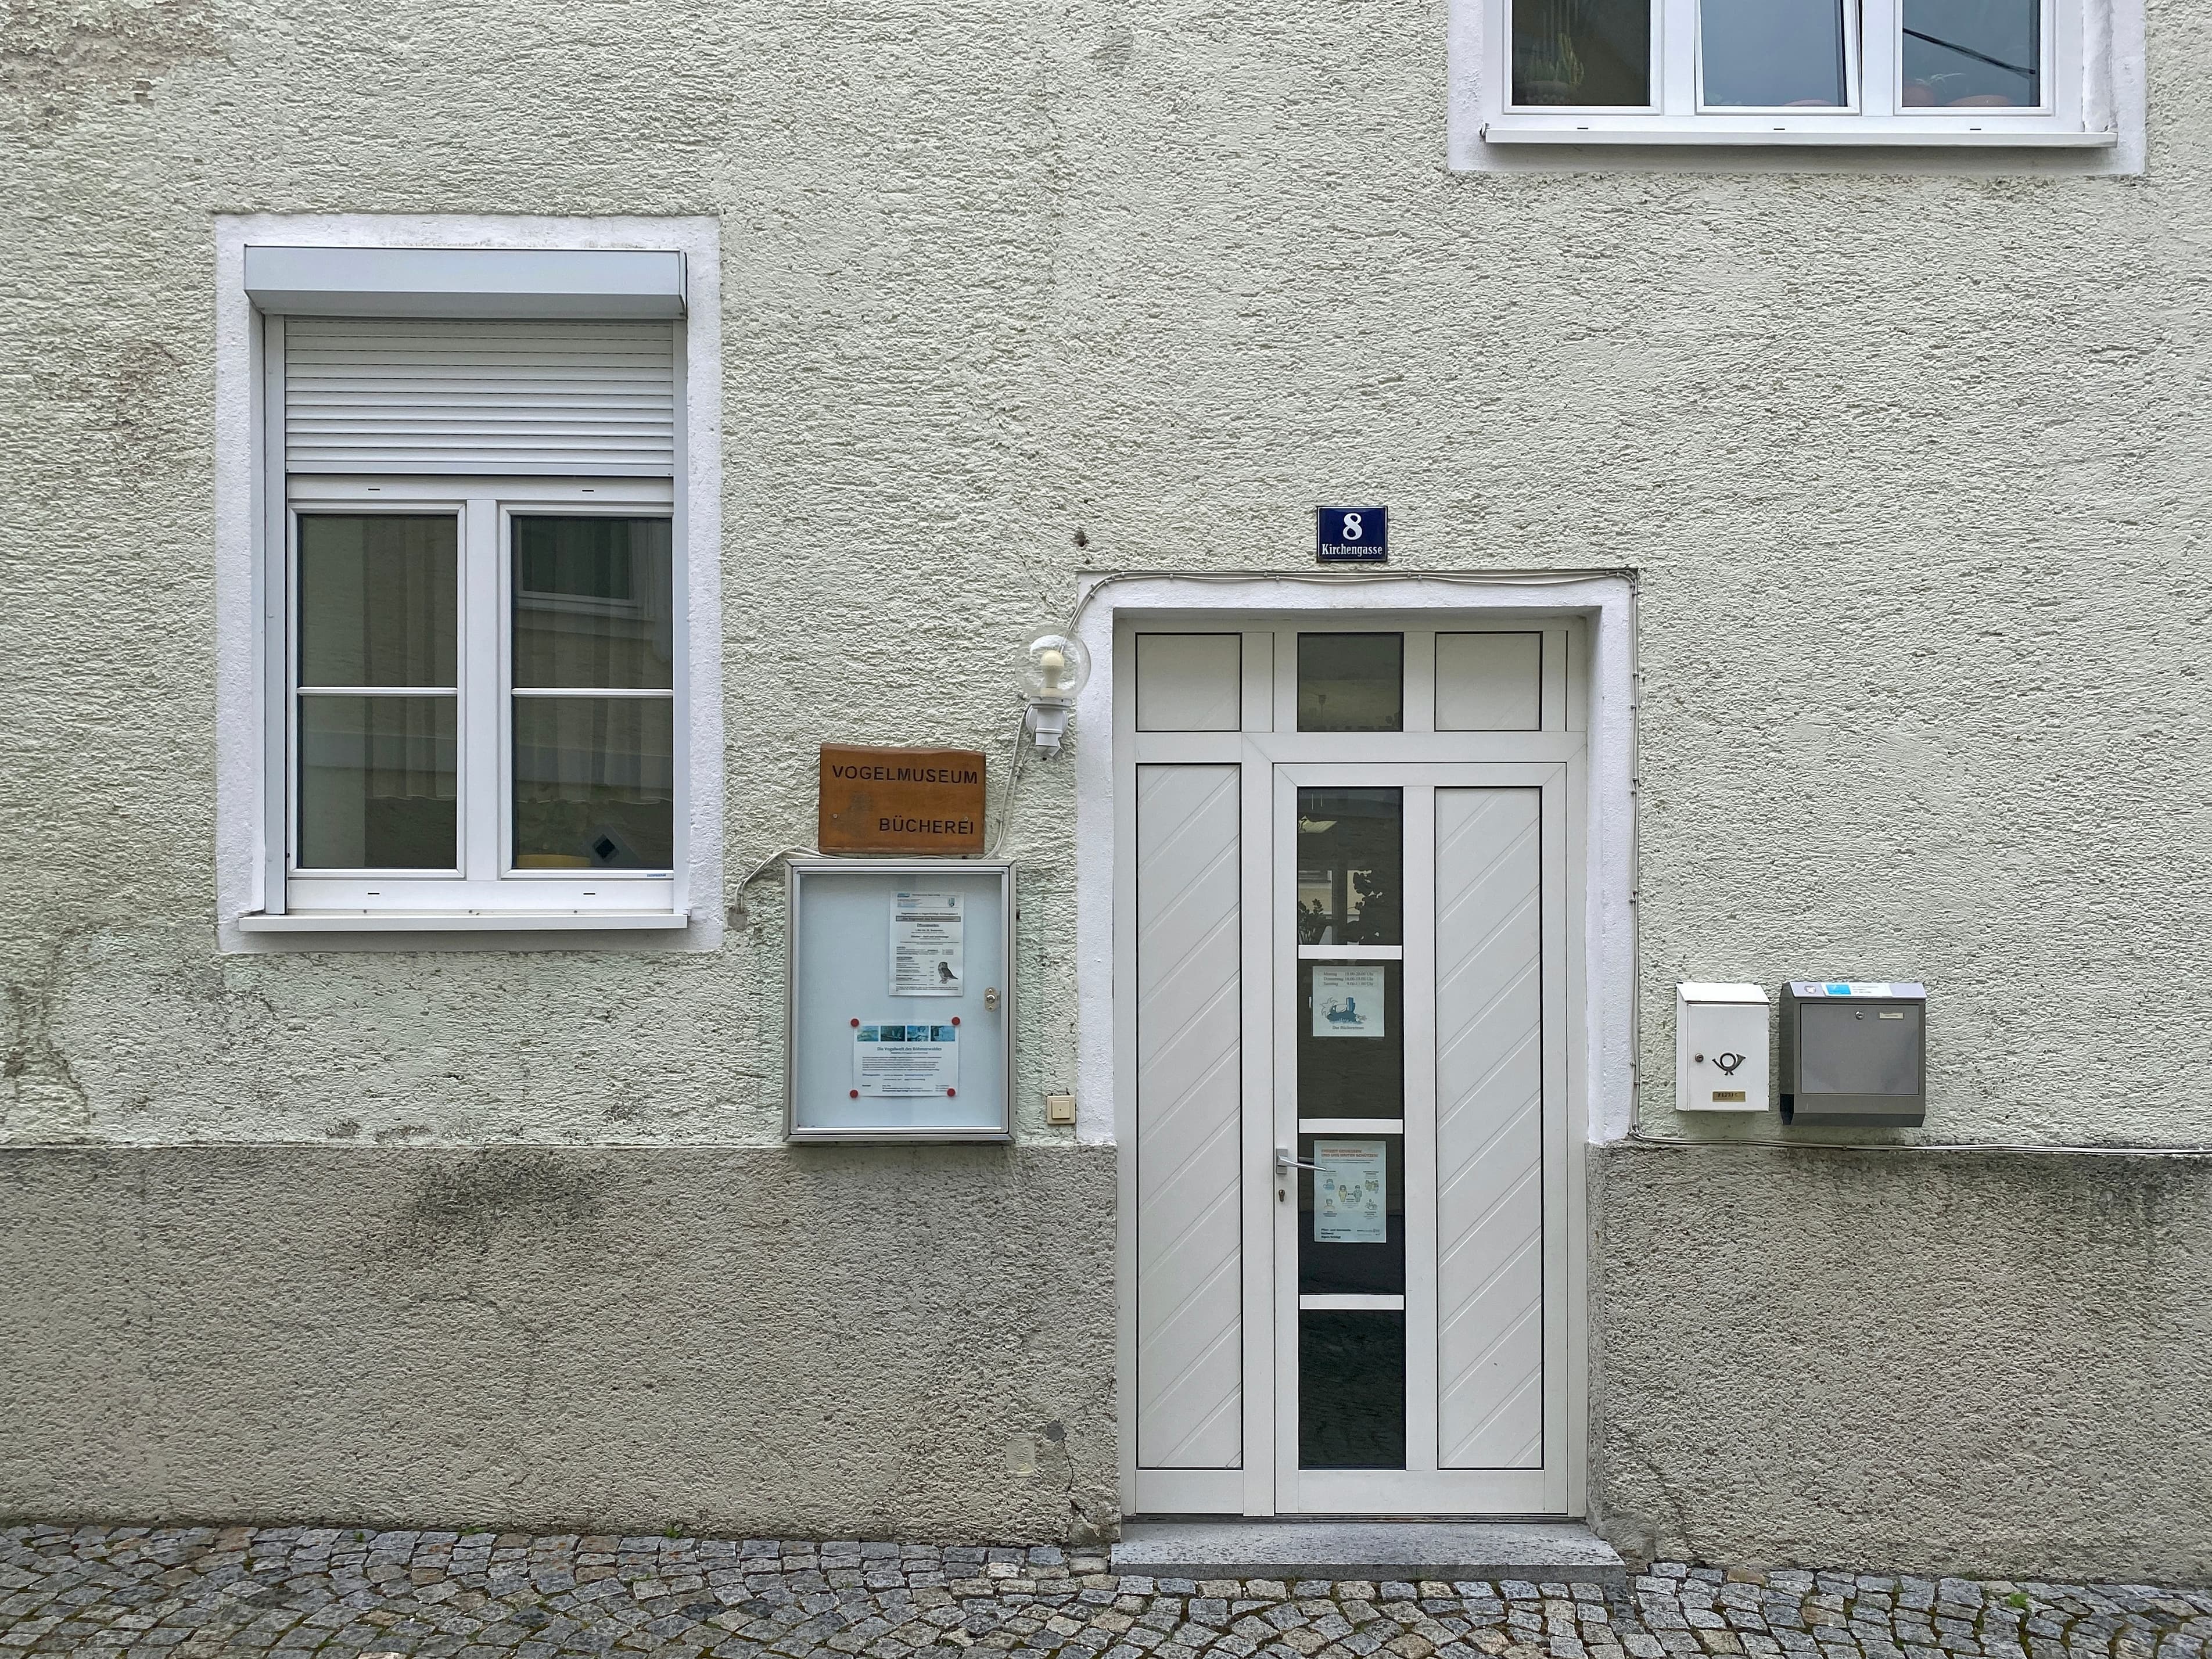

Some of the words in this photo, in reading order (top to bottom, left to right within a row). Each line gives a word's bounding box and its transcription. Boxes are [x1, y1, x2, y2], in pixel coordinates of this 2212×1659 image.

[1342, 512, 1363, 541] 8
[1322, 543, 1383, 558] Kirchengasse
[832, 764, 978, 784] VOGELMUSEUM
[879, 815, 974, 835] BÜCHEREI
